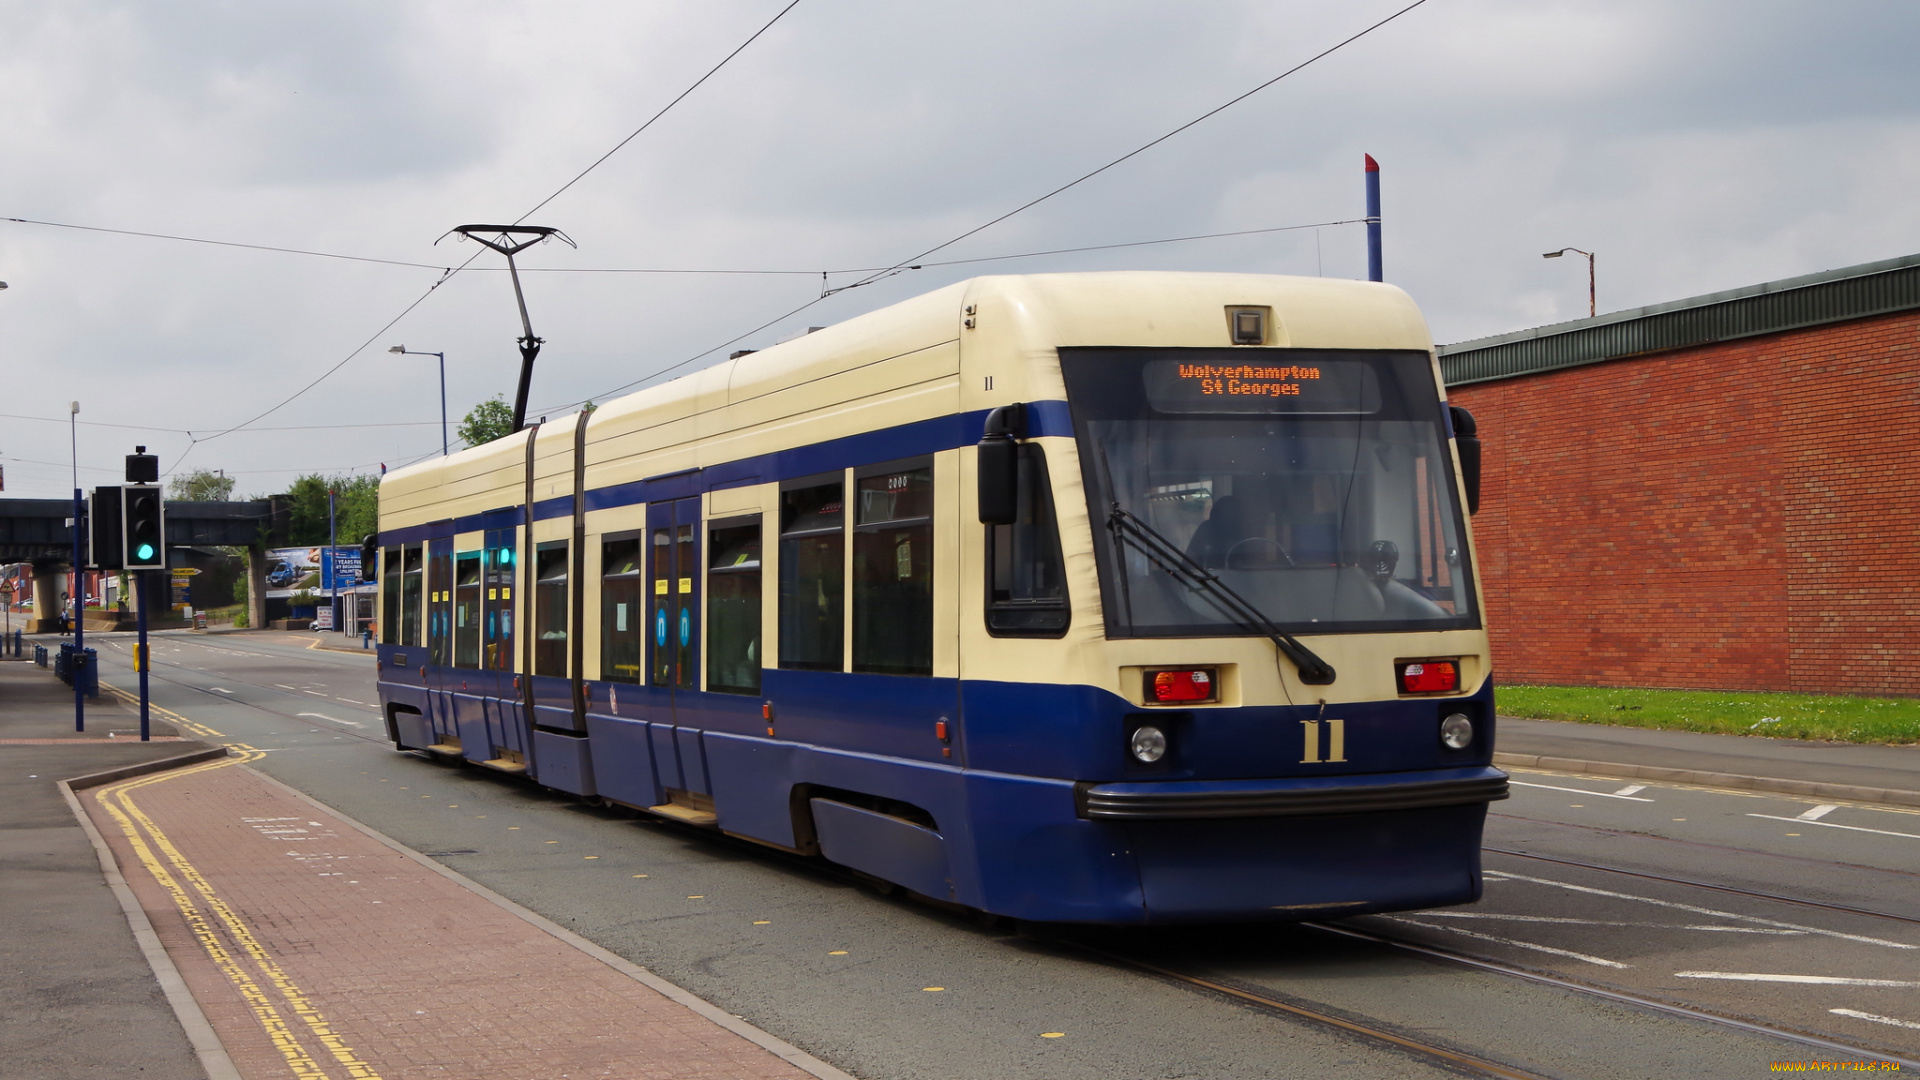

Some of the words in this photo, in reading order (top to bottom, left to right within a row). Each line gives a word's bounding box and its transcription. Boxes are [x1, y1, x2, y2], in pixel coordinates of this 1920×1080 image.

[1179, 364, 1320, 381] Wolverhampton
[984, 376, 994, 391] 11
[1201, 379, 1224, 395] St
[1227, 379, 1300, 397] Georges
[1299, 720, 1347, 763] 11
